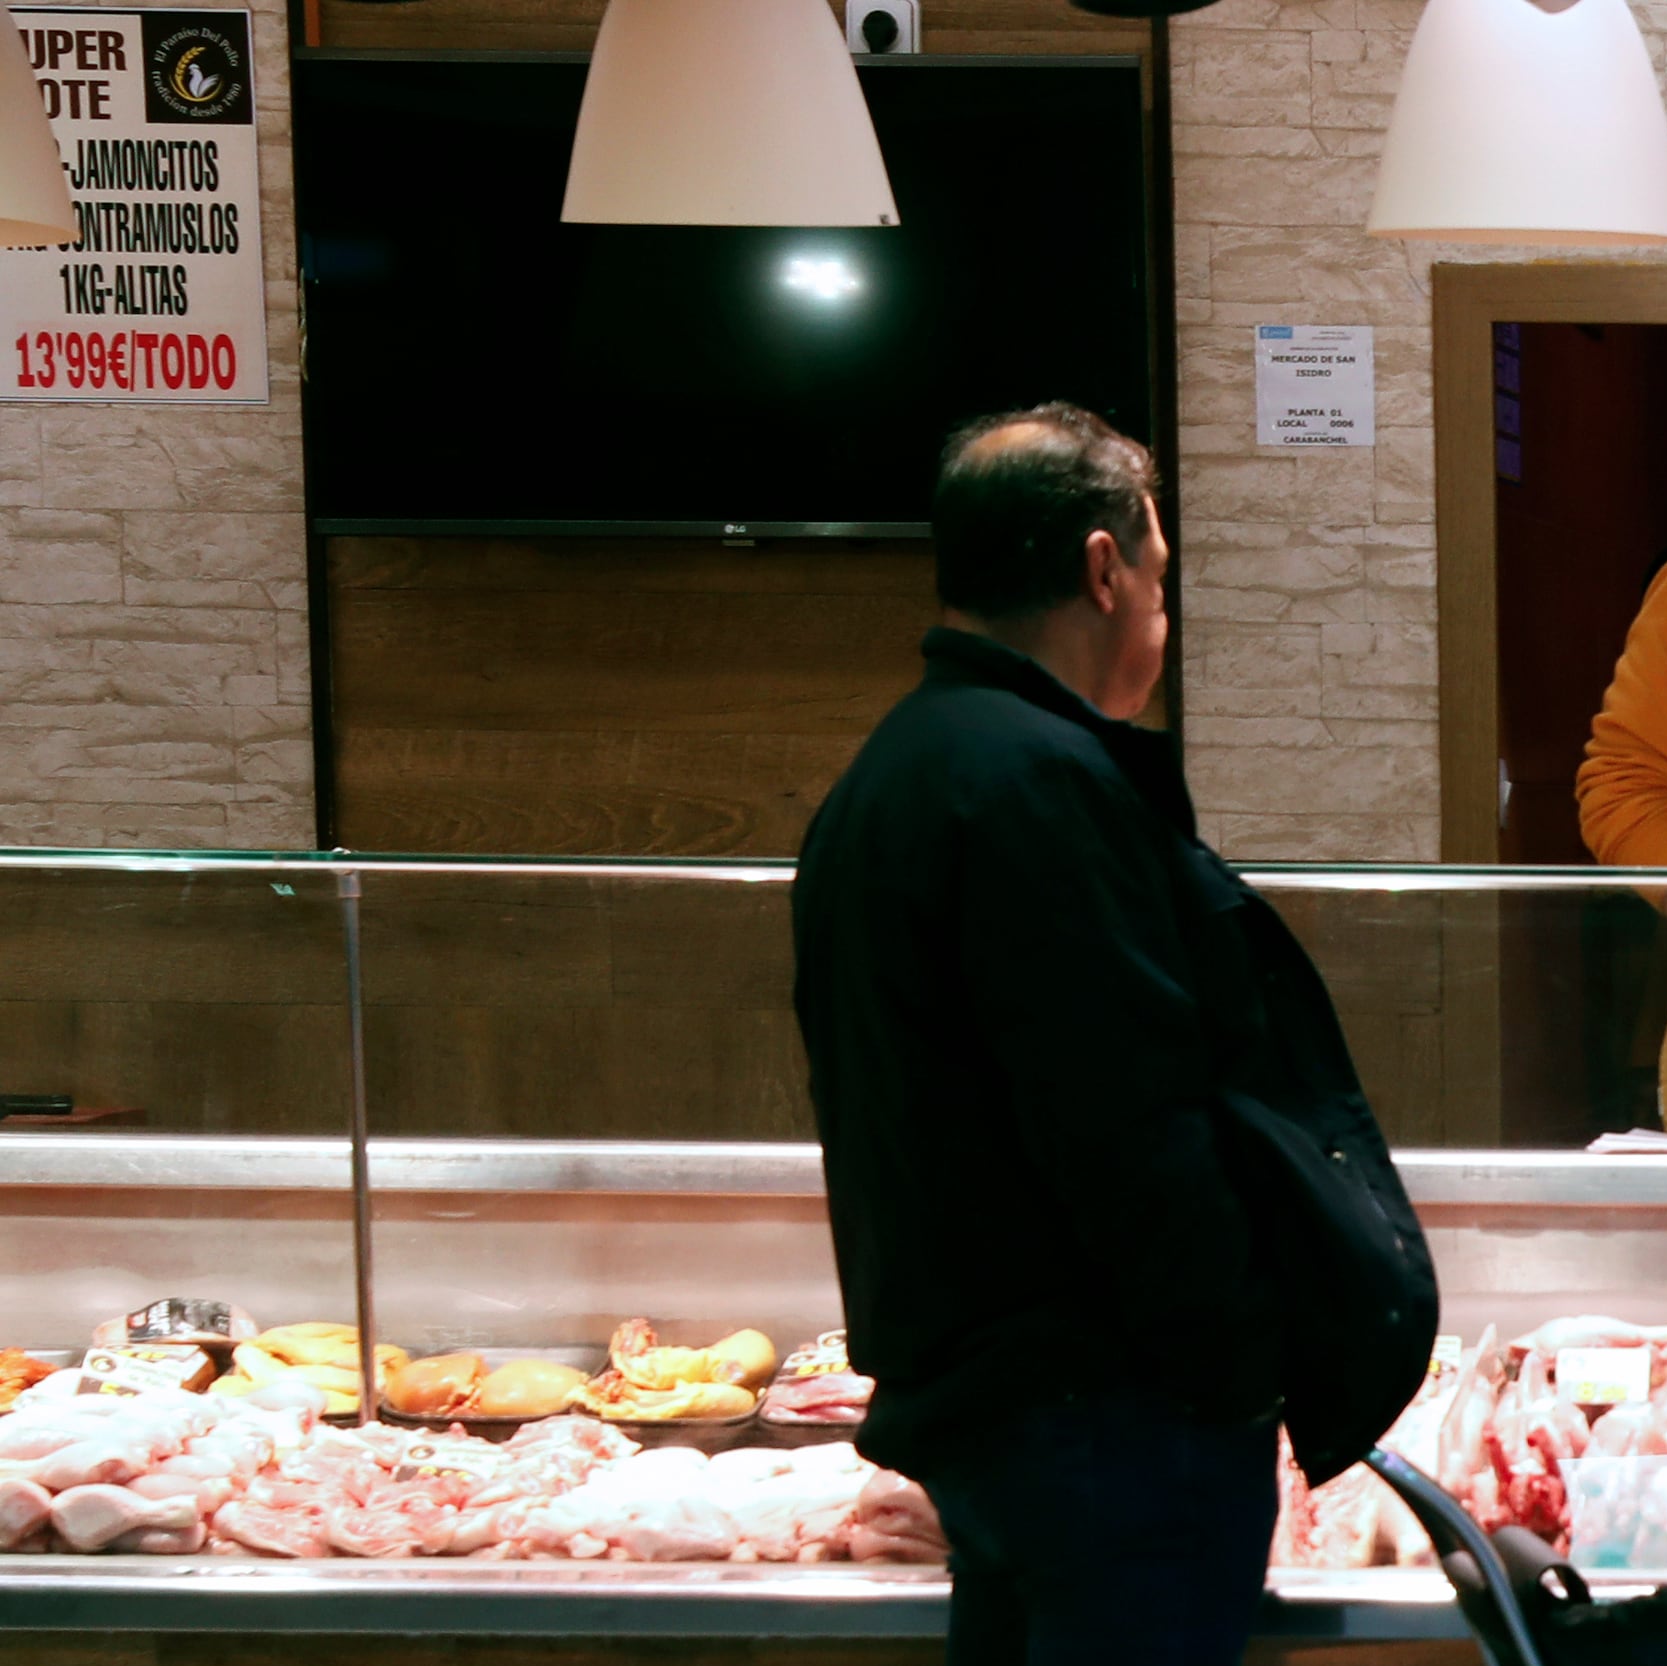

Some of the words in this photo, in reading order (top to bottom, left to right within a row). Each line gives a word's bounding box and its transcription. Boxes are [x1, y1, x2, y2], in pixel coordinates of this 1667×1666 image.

[18, 29, 127, 71] UPER
[36, 78, 112, 120] OTE
[55, 138, 218, 191] -JAMONCITOS
[60, 264, 188, 316] 1KG-ALITAS
[16, 330, 237, 392] 13'99€/TODO
[1272, 355, 1317, 364] MERCADO
[1321, 355, 1333, 364] DE
[1336, 355, 1356, 364] SAN
[1296, 369, 1332, 377] ISIDRO
[1277, 419, 1308, 428] LOCAL
[1288, 408, 1325, 417] PLANTA
[1330, 409, 1343, 417] 01
[1283, 436, 1348, 444] CARABANCHEL
